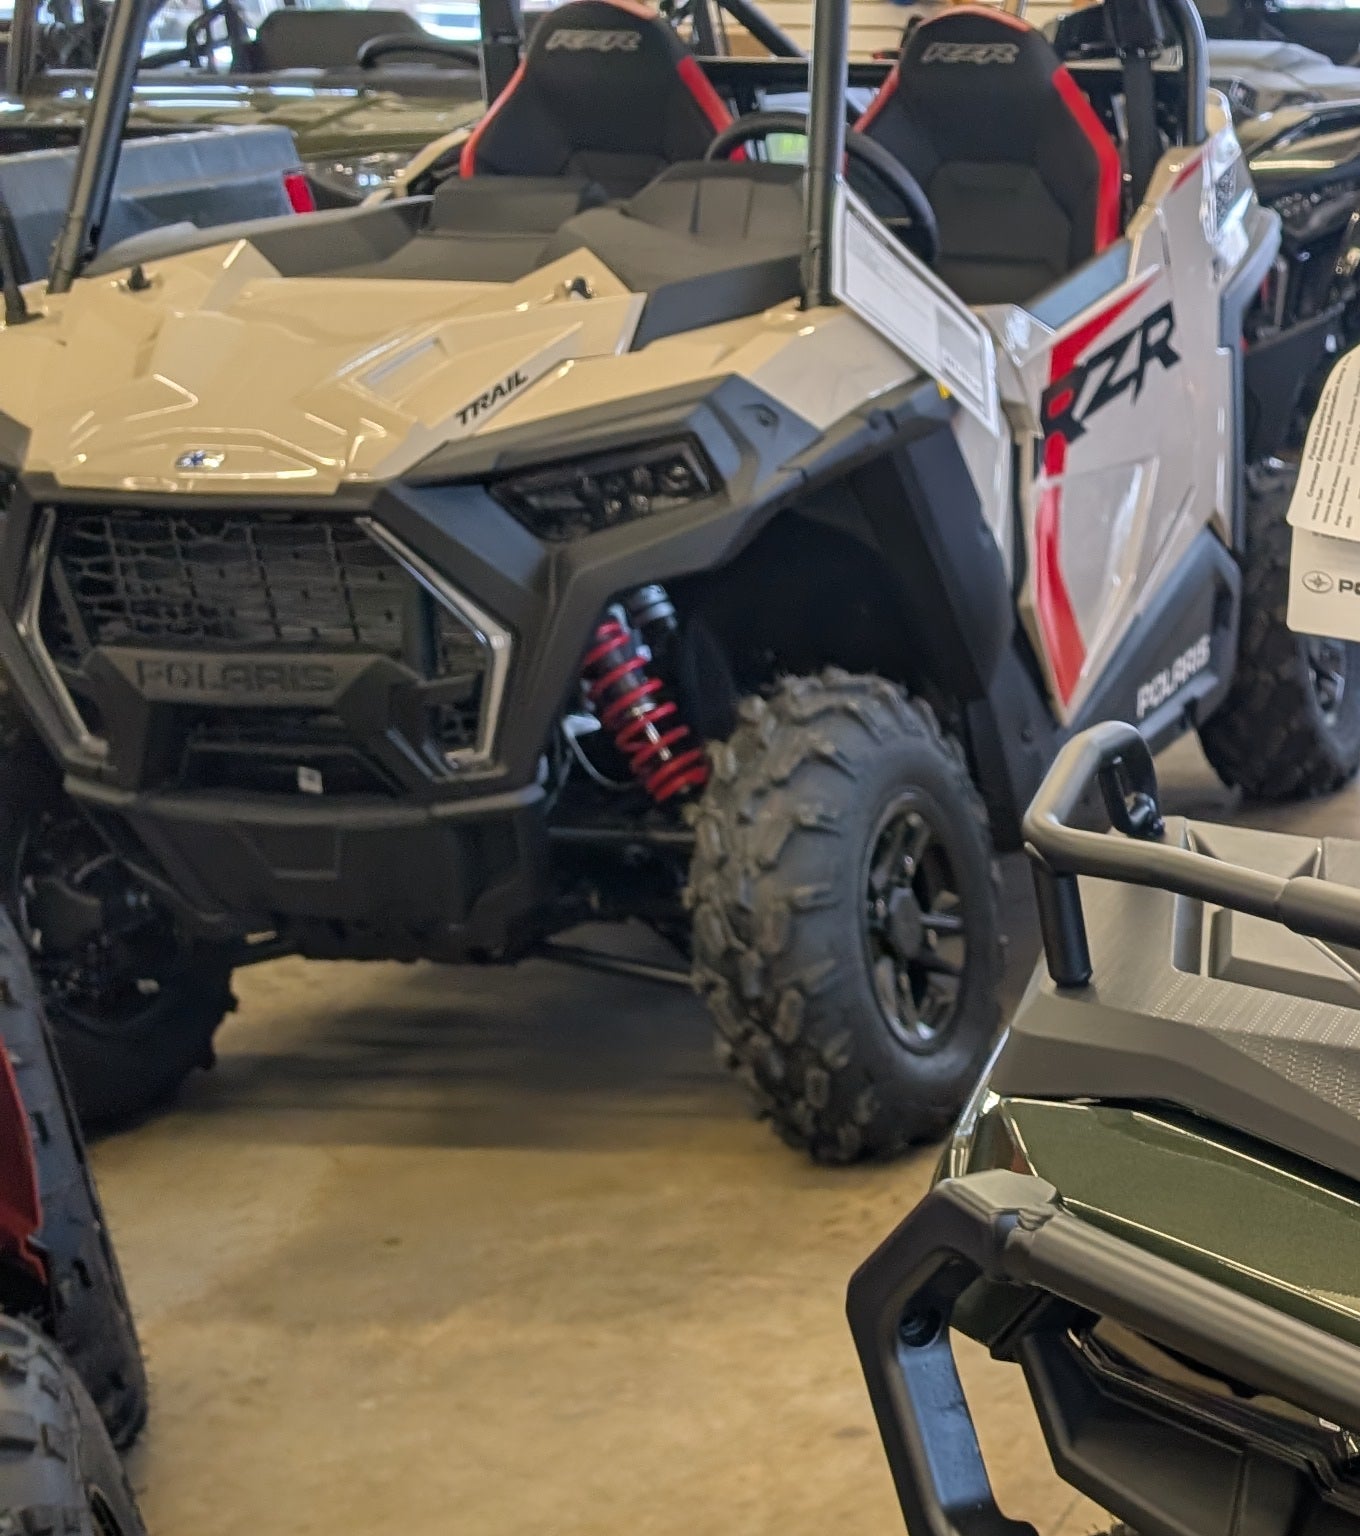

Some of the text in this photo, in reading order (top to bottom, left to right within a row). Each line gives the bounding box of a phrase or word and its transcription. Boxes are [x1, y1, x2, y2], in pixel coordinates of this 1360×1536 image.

[454, 371, 529, 425] TRAIL
[135, 660, 336, 692] POLARIS
[1136, 634, 1211, 718] POLARIS
